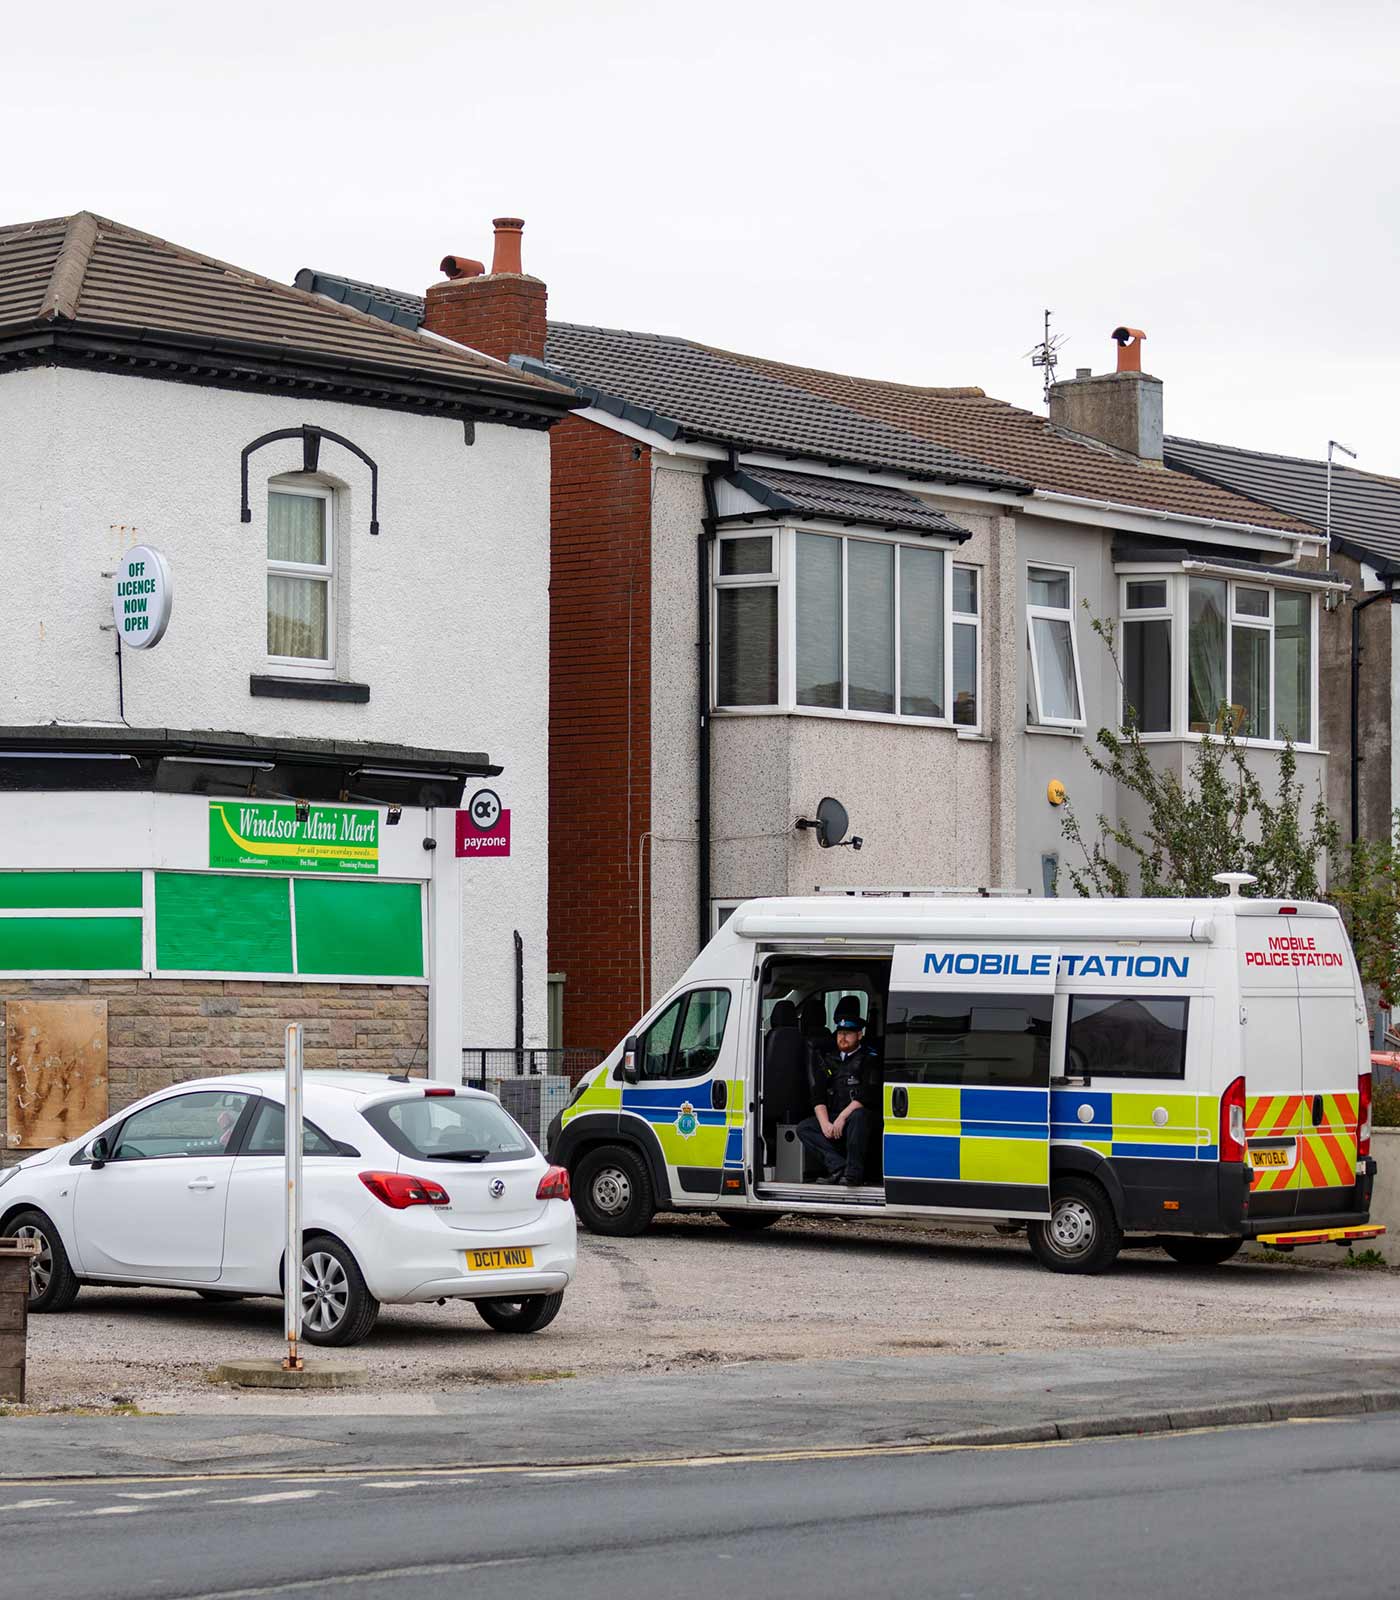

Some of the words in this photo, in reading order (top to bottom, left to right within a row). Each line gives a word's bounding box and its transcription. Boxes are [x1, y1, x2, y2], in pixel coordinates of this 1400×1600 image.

[128, 562, 145, 577] OFF
[117, 579, 156, 596] LICENCE
[124, 598, 147, 614] NOW
[124, 616, 149, 632] OPEN
[239, 808, 300, 839] Windsor
[302, 812, 337, 841] Mini
[340, 814, 376, 842] Mart
[296, 846, 306, 855] for
[315, 848, 329, 856] your
[464, 837, 507, 850] payzone
[1268, 937, 1316, 951] MOBILE
[922, 953, 1051, 976] MOBILE
[1245, 952, 1290, 966] POLICE
[1291, 953, 1343, 967] STATION
[473, 1251, 501, 1267] DC17
[503, 1250, 527, 1265] WNU
